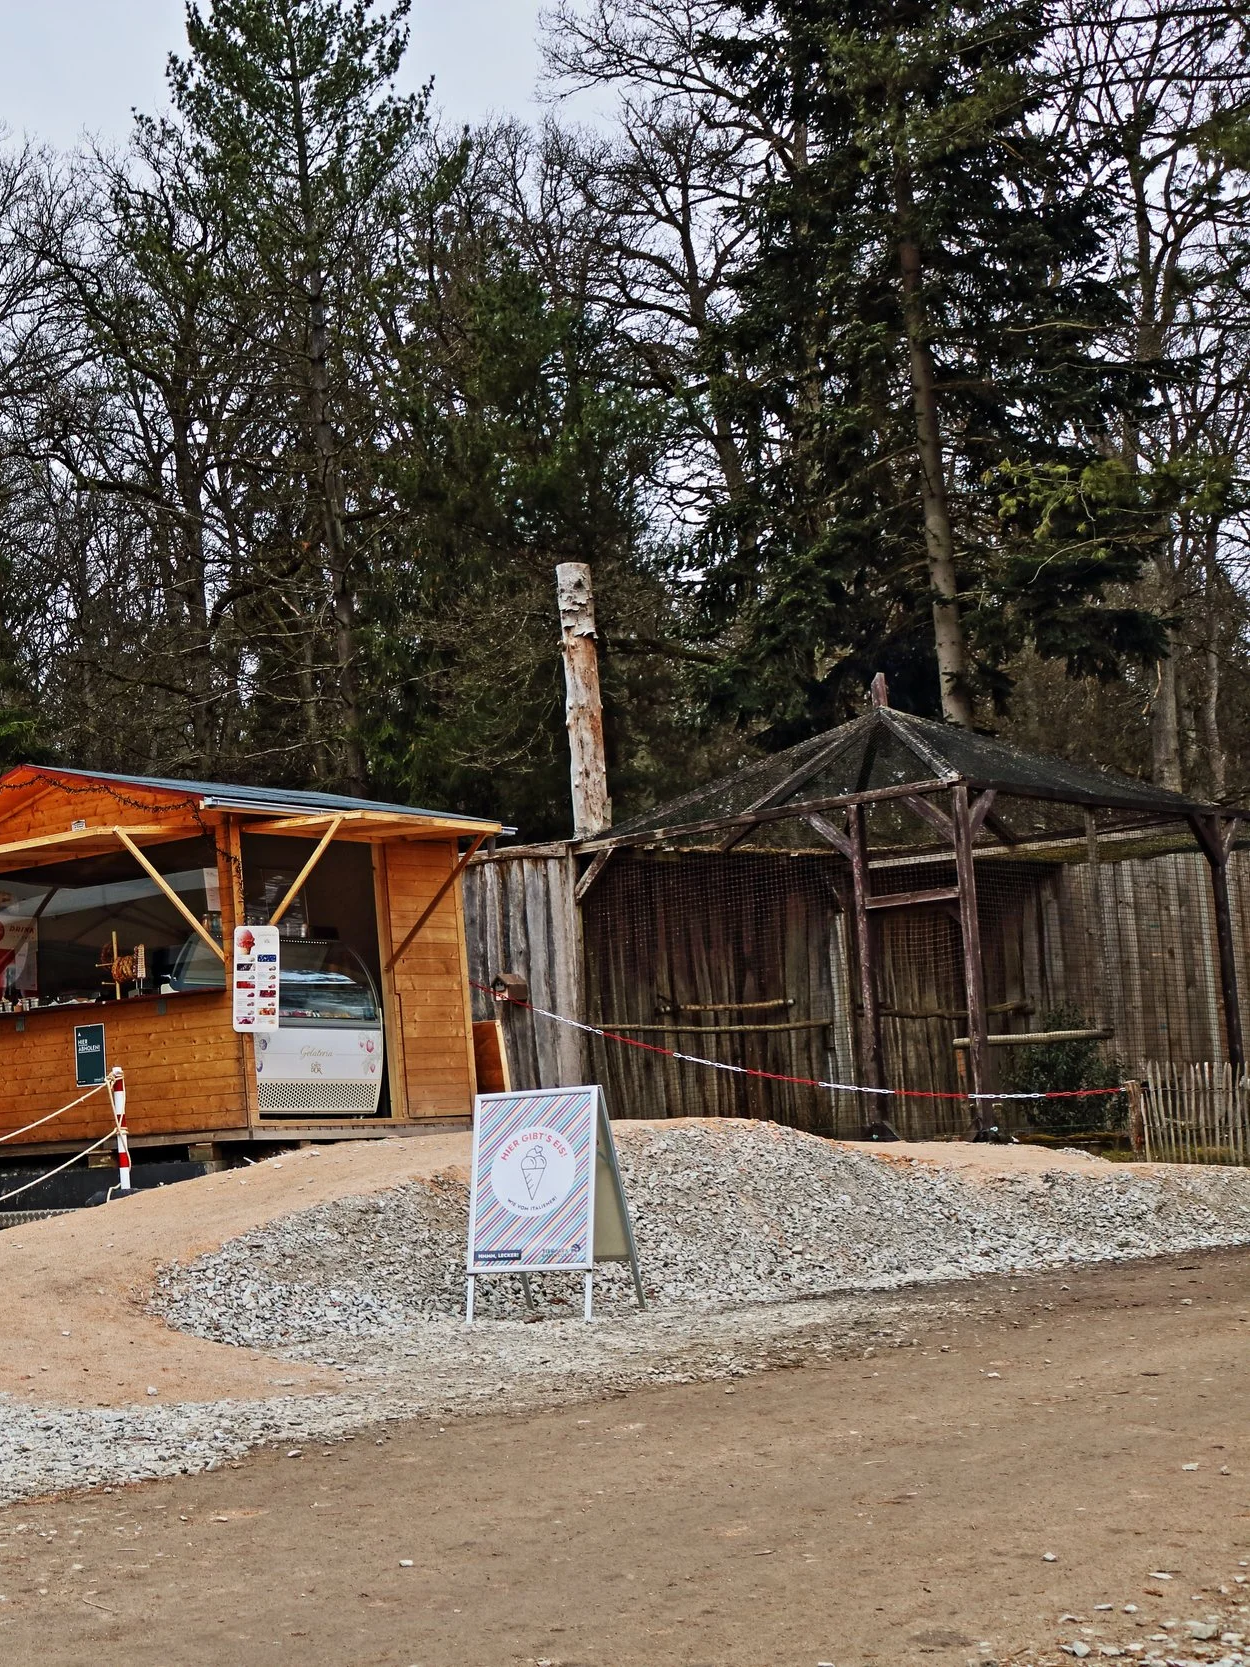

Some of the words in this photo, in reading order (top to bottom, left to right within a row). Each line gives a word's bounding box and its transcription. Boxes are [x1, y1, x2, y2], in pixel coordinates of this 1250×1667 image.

[501, 1140, 520, 1161] HIER
[522, 1132, 553, 1143] GIBT'S
[553, 1140, 568, 1157] EIS!
[508, 1198, 517, 1207] WIE
[531, 1196, 558, 1211] ITALIENER!
